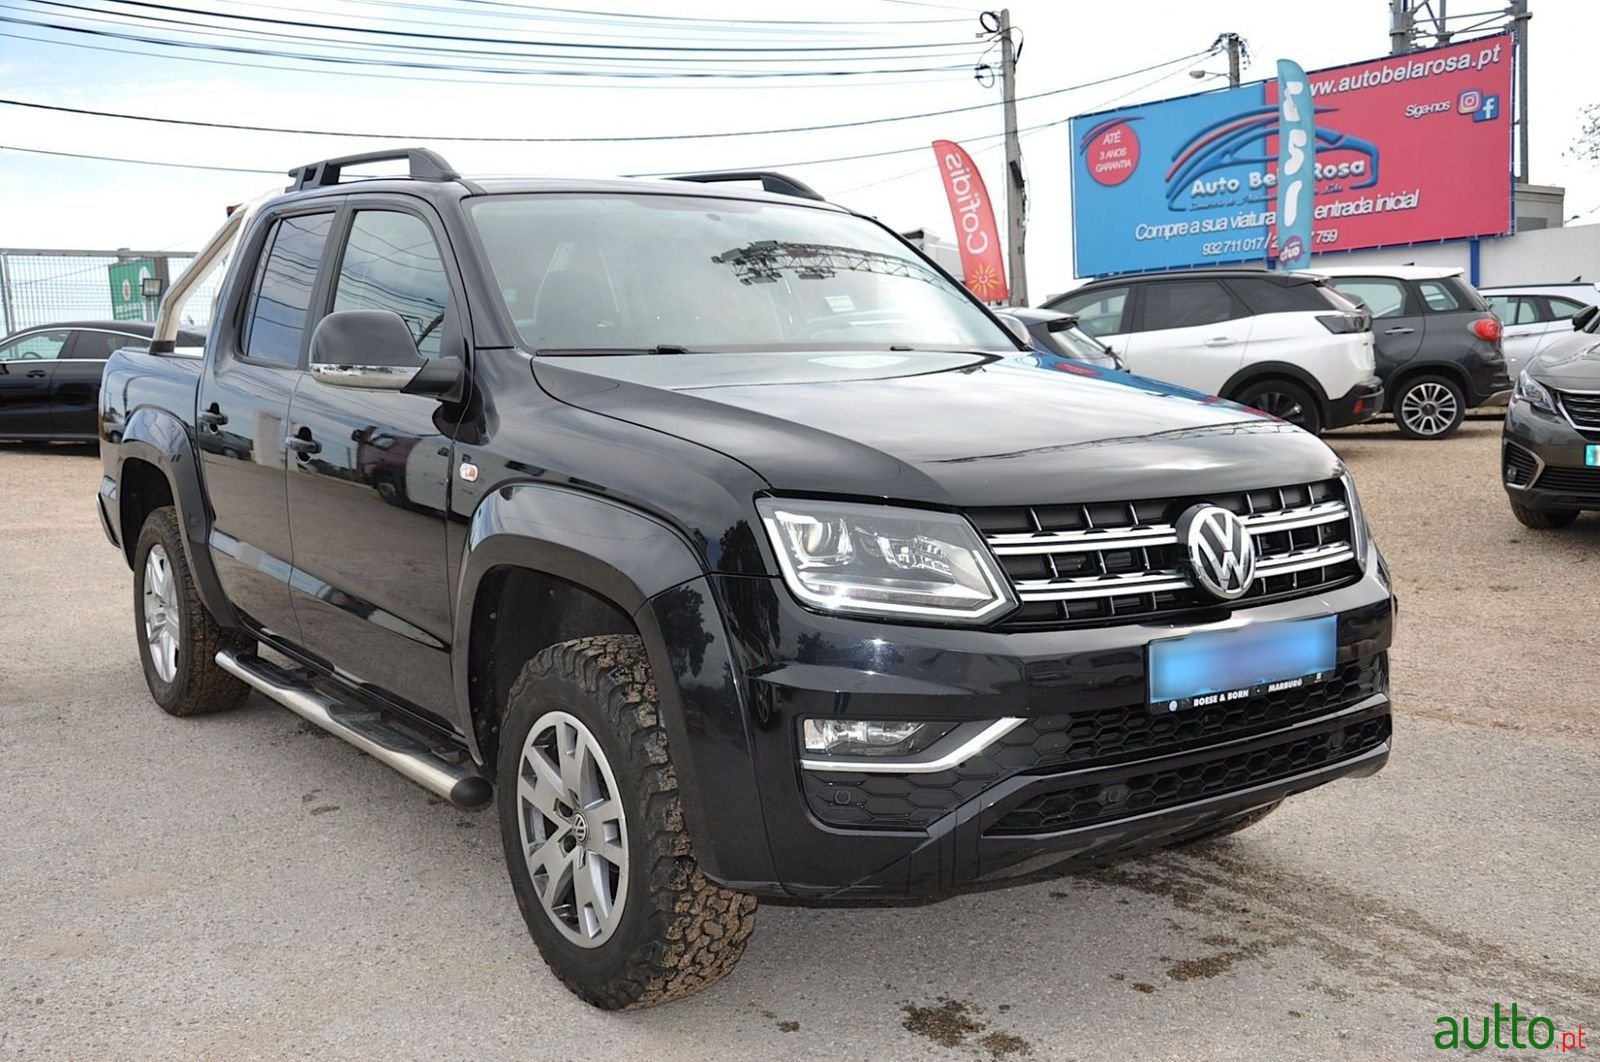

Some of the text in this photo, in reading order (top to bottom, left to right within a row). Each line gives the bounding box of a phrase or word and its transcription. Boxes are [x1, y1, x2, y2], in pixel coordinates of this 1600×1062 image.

[1405, 100, 1451, 120] Siga-nos
[1103, 129, 1121, 146] ATÉ
[1105, 147, 1128, 160] ANOS
[1095, 158, 1132, 173] GARANTIA
[1191, 178, 1240, 197] Auto
[1135, 188, 1420, 240] Compre a sua viatura entrada inicial
[1202, 241, 1222, 256] 932
[1224, 239, 1242, 254] 711
[1243, 236, 1265, 252] 017
[1316, 228, 1339, 244] 759
[1194, 678, 1303, 707] BOESE & BORN MARBURG
